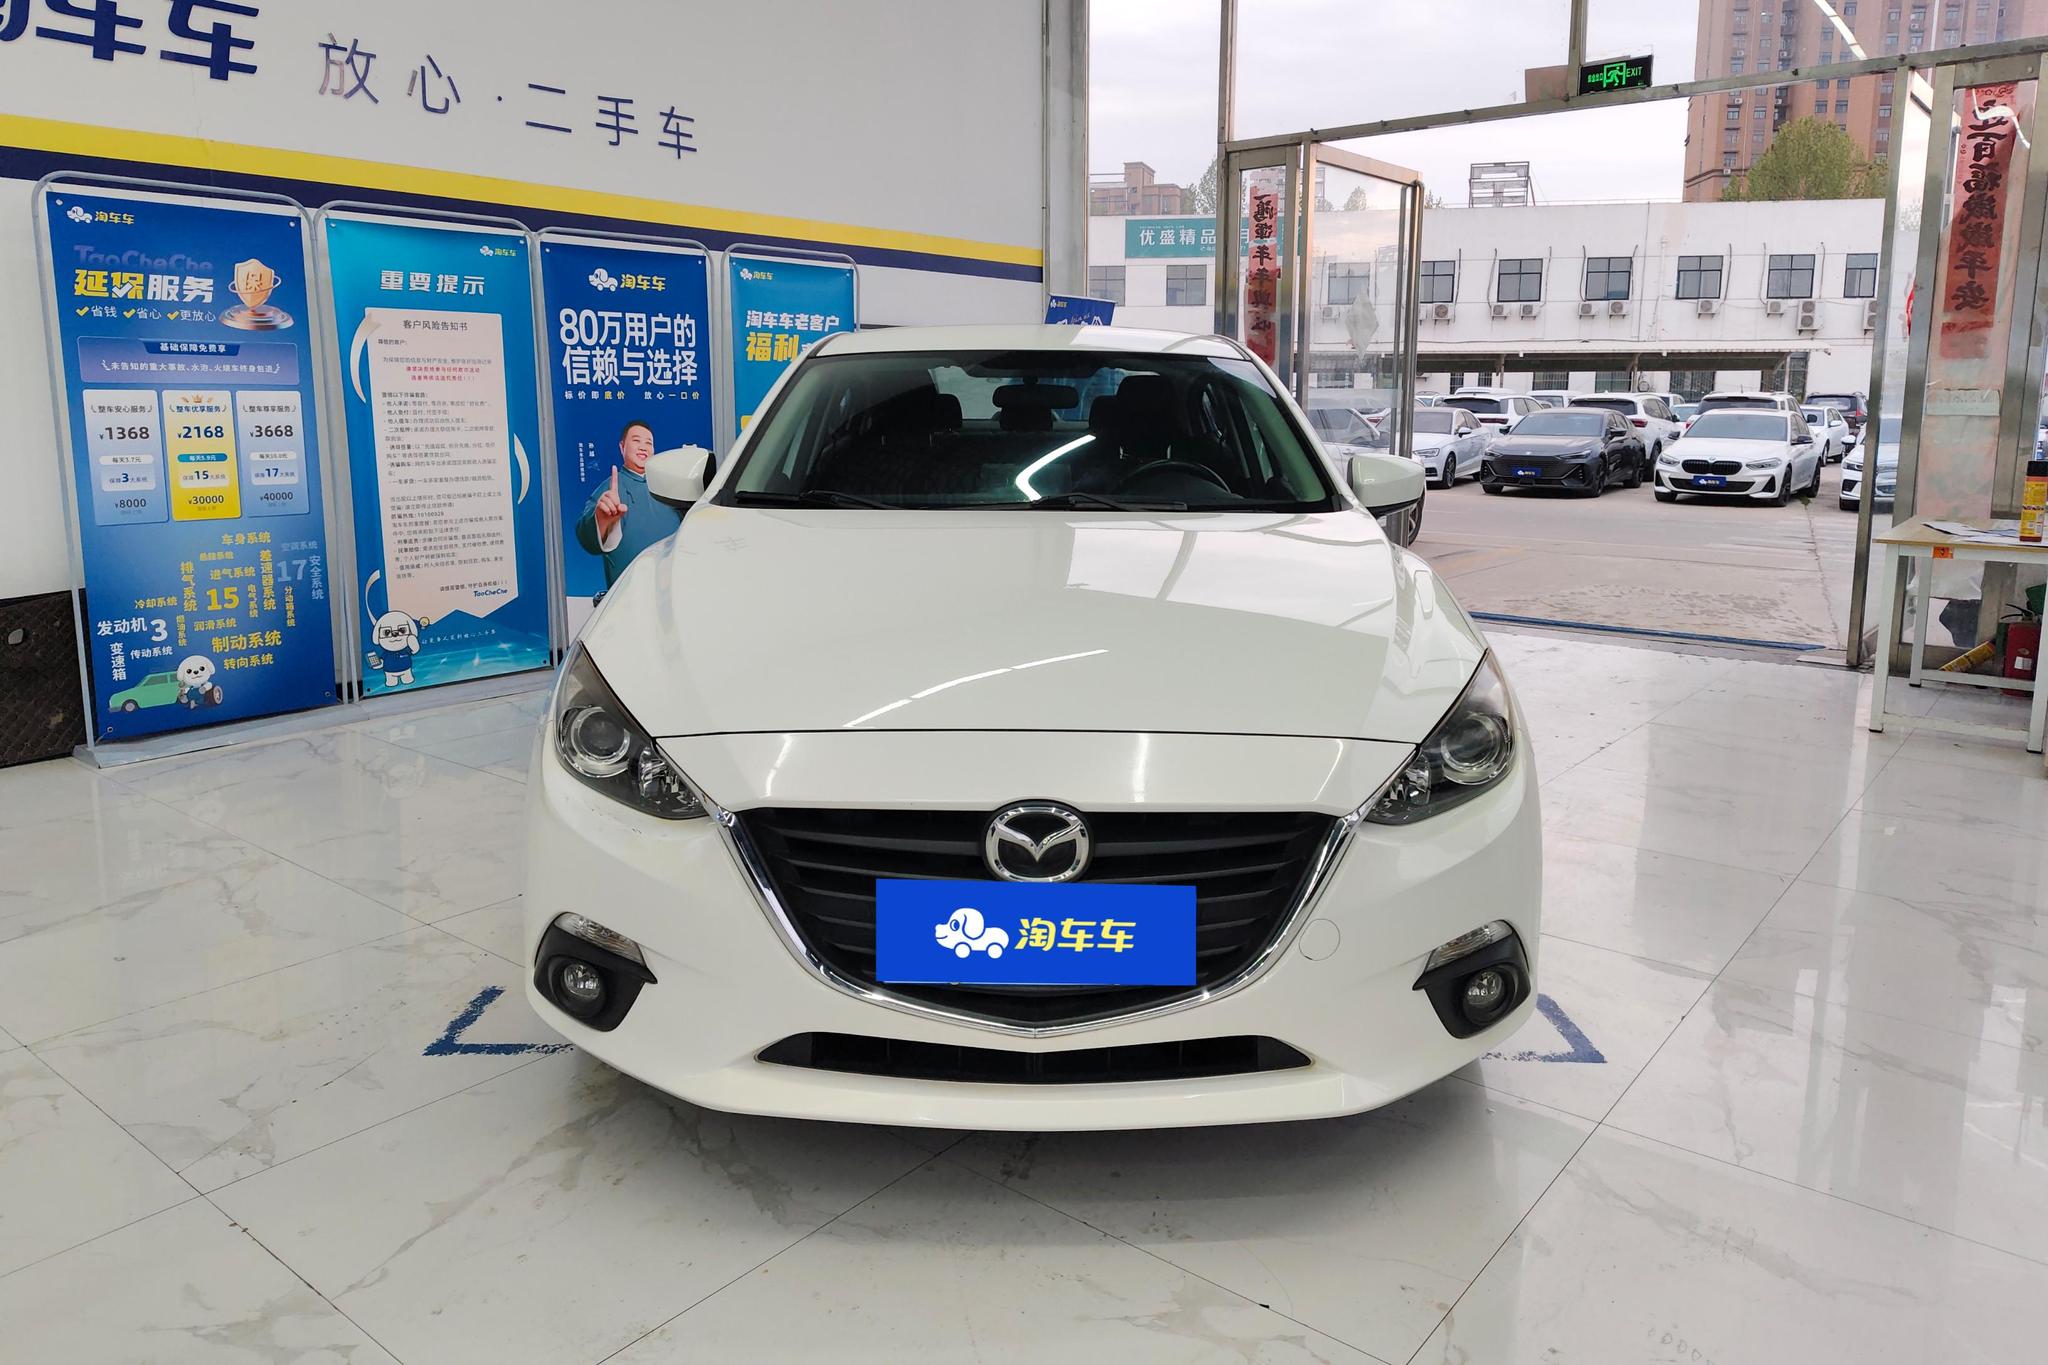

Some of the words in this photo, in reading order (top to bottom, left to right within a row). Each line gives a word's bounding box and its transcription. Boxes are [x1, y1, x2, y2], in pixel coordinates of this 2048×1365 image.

[0, 0, 260, 81] 车车
[1626, 66, 1643, 78] EXIT
[95, 210, 135, 225] 淘车车
[73, 245, 213, 271] TaoCheChe
[74, 269, 214, 304] 延保服务
[380, 270, 485, 296] 重要提示
[620, 274, 666, 292] 淘车车
[753, 271, 774, 281] 淘车车
[91, 305, 119, 319] 省钱
[136, 307, 163, 320] 省心
[179, 310, 217, 323] 更放心
[745, 310, 840, 332] 淘车车老客户
[403, 320, 469, 331] 客户风险告知书
[559, 308, 697, 348] 80万用户的
[159, 342, 227, 353] 基础保障免费享
[562, 346, 698, 387] 信赖与选择
[564, 391, 625, 401] 标价即底价
[644, 391, 700, 401] 放心一口价
[177, 425, 225, 439] ¥2168
[221, 531, 272, 546] 车身系统
[210, 566, 256, 582] 进气系统
[260, 549, 278, 611] 差速器系统
[277, 558, 308, 583] 17
[309, 554, 325, 601] 安全系统
[180, 561, 198, 612] 排气系统
[473, 588, 508, 598] TaoCheChe
[134, 596, 178, 610] 冷却系统
[206, 586, 240, 612] 15
[96, 617, 149, 638] 发动机
[150, 618, 169, 642] 3
[211, 629, 282, 654] 制动系统
[109, 642, 128, 682] 变速箱
[130, 645, 174, 661] 传动系统
[223, 652, 274, 671] 转向系统
